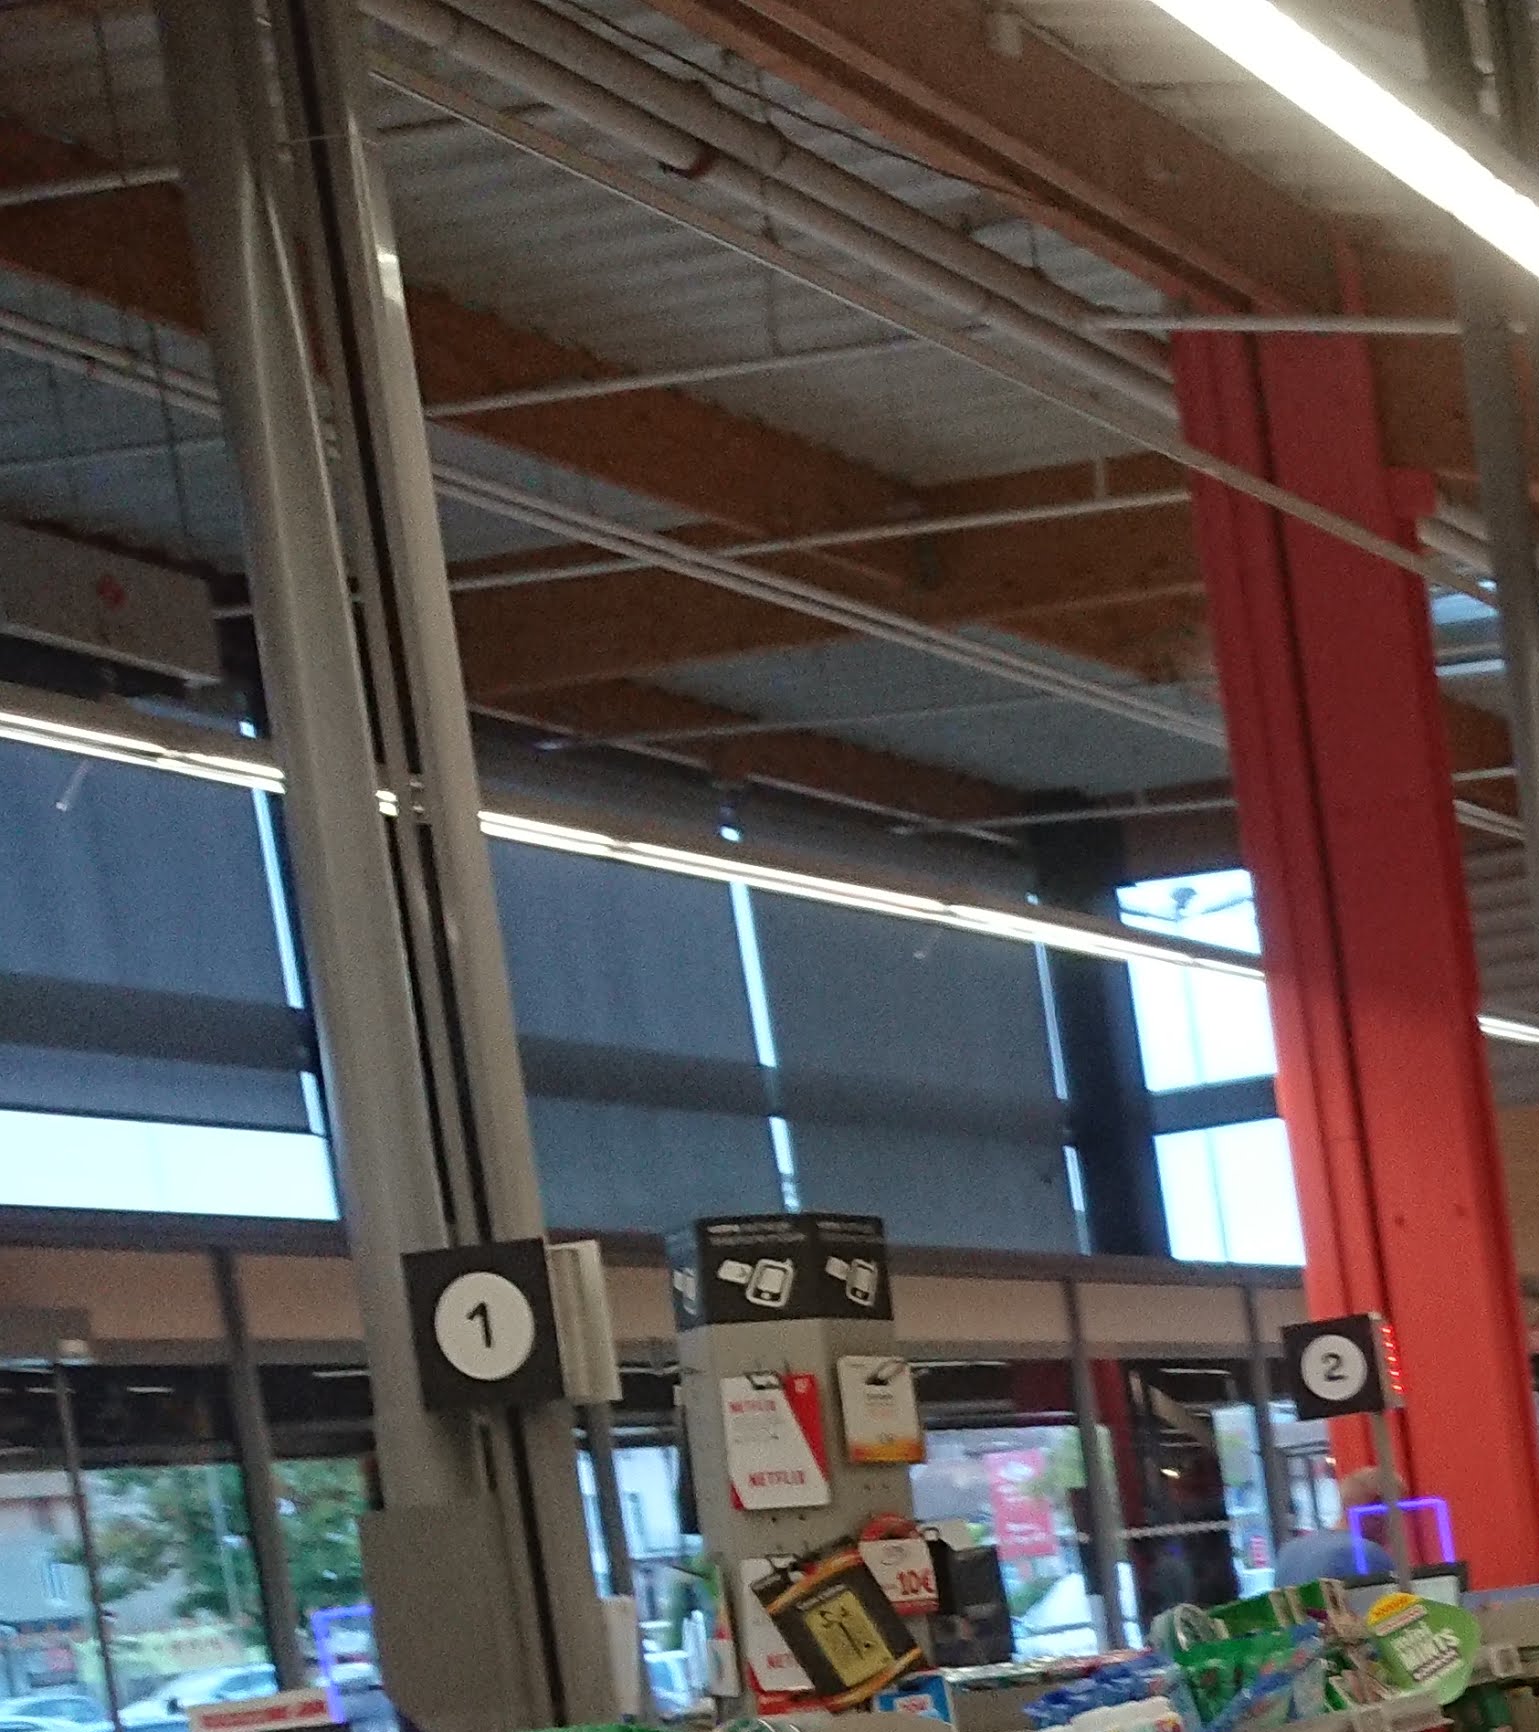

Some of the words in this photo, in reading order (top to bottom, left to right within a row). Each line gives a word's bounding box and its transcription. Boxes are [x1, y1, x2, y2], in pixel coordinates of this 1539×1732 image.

[465, 1301, 493, 1349] 1
[1321, 1352, 1348, 1382] 2
[748, 1470, 806, 1487] NETFLIX
